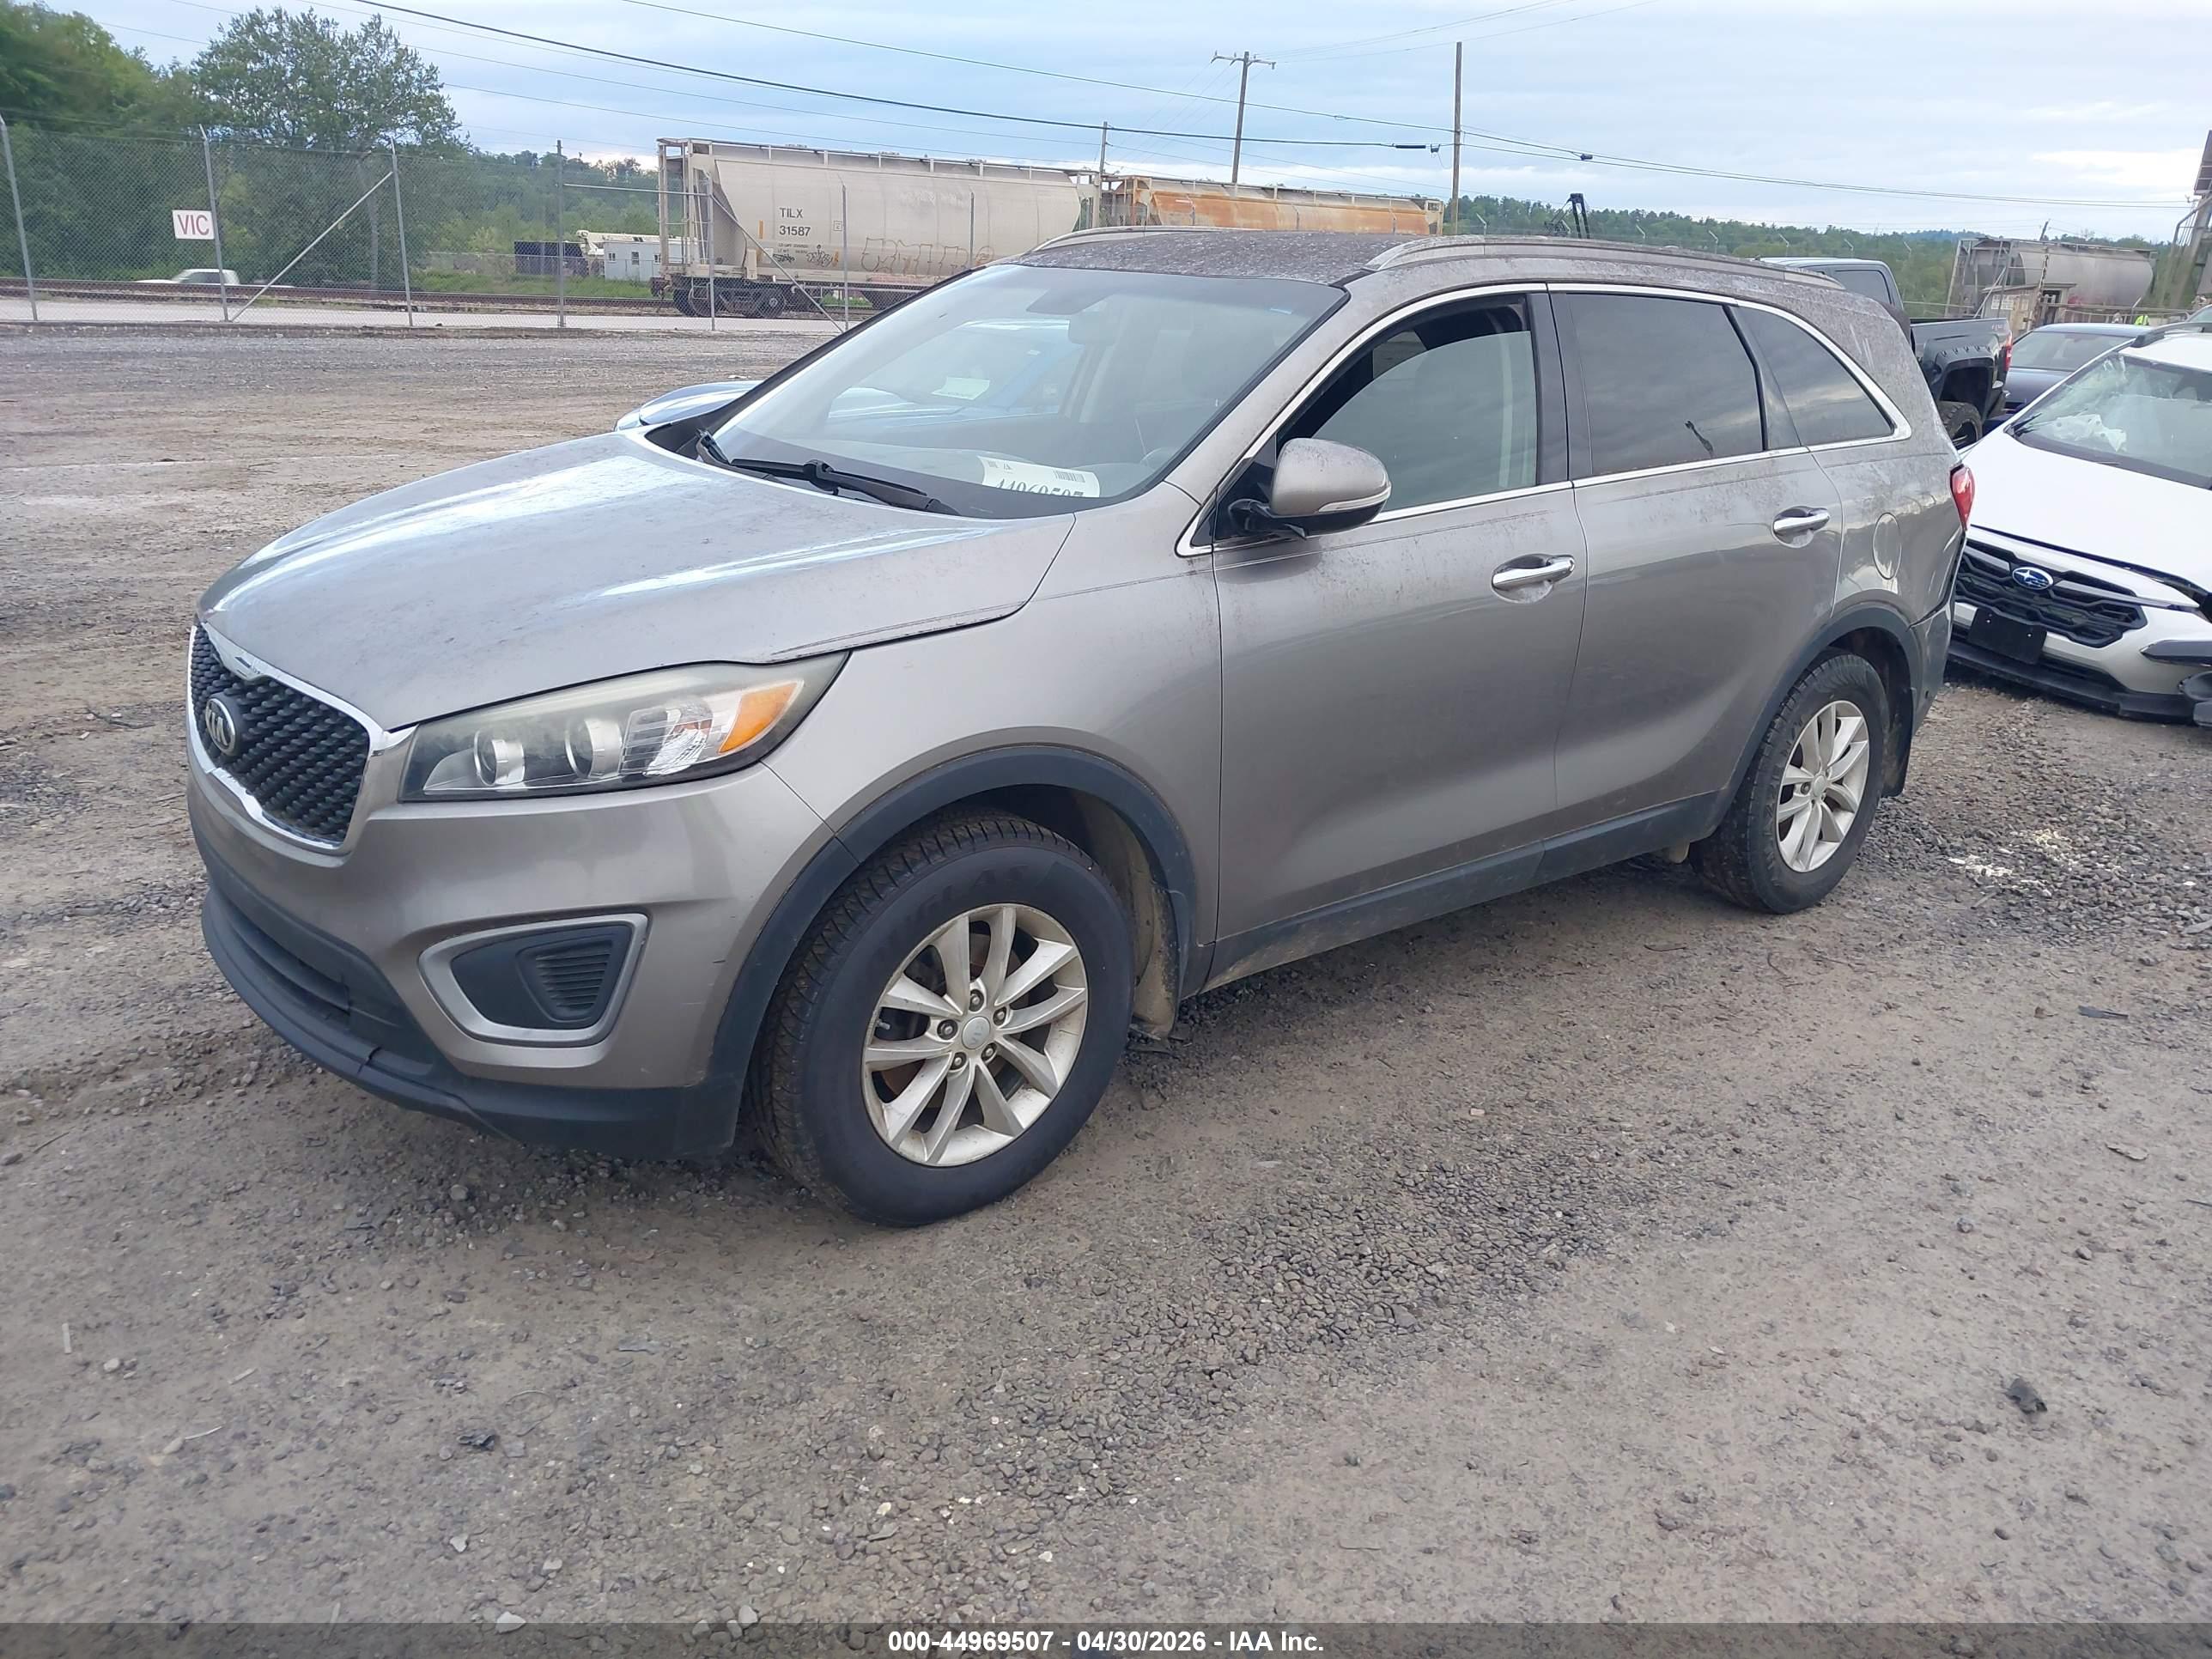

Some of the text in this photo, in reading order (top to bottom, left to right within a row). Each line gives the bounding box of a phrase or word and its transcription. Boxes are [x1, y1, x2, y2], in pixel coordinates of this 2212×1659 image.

[779, 207, 803, 219] TILX
[177, 214, 210, 236] VIC
[779, 225, 811, 236] 31587
